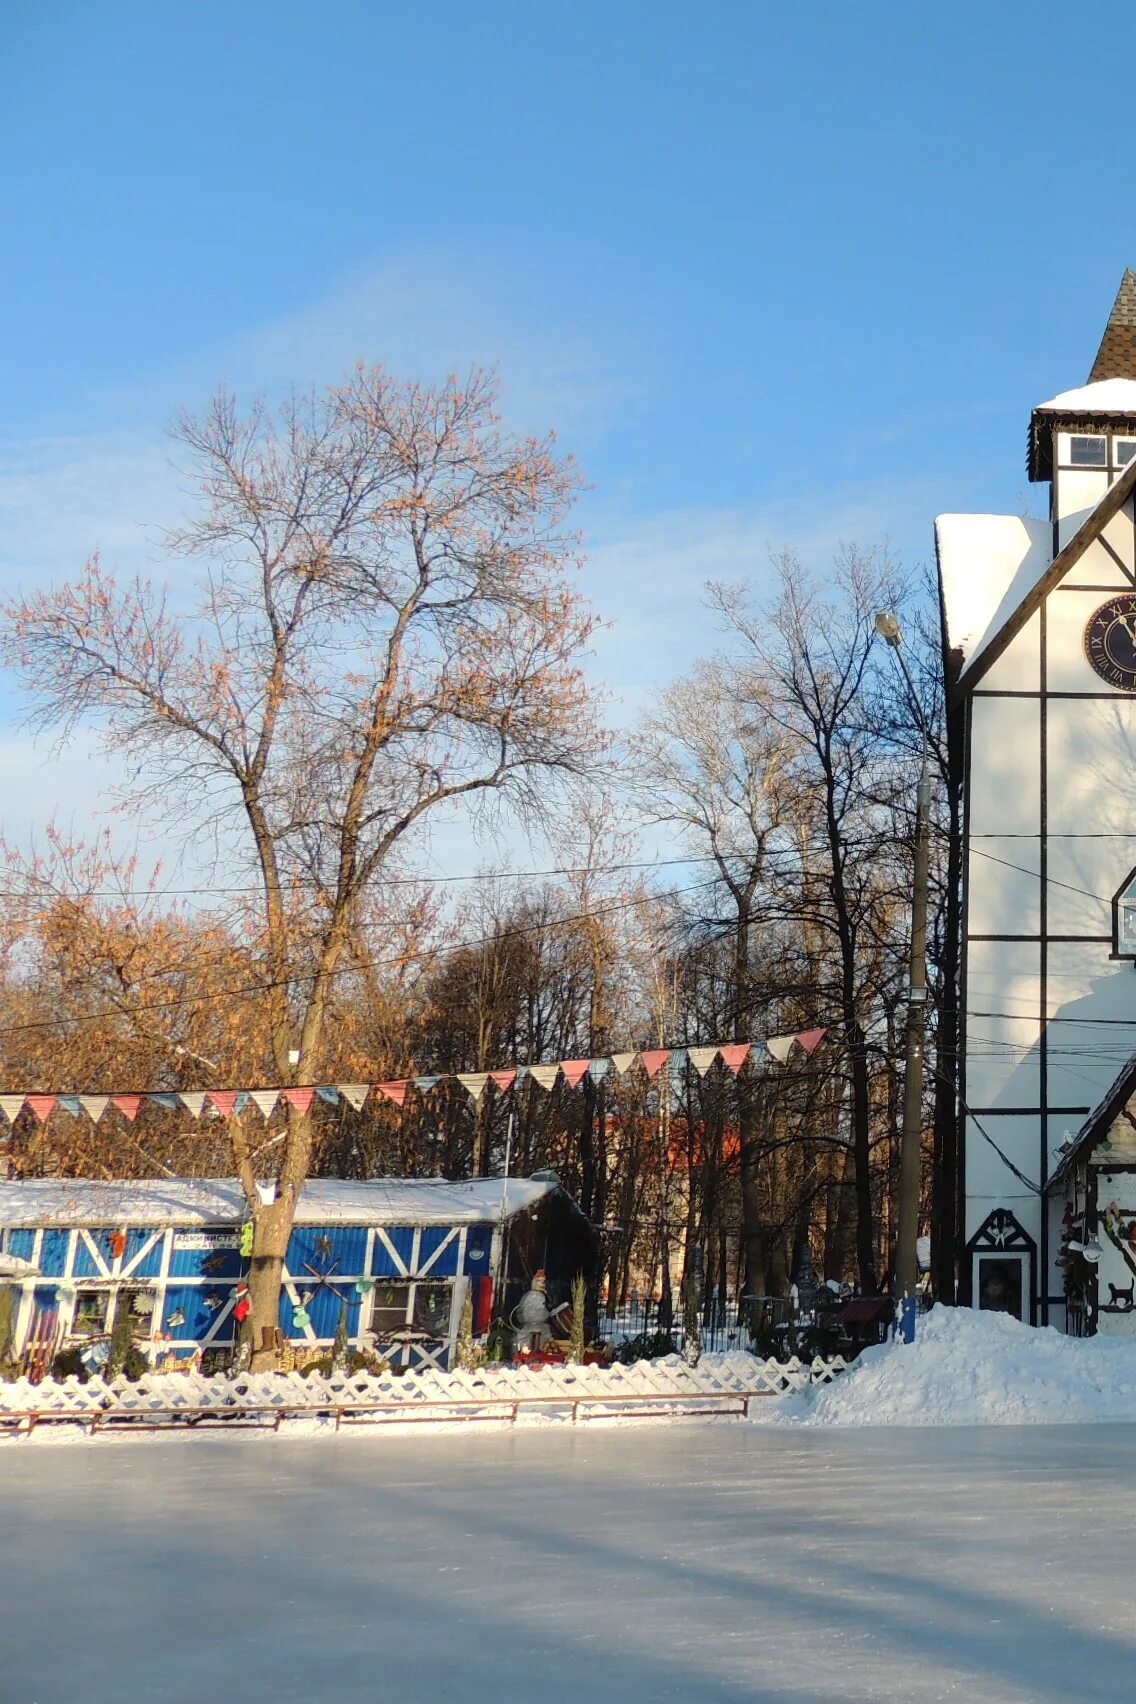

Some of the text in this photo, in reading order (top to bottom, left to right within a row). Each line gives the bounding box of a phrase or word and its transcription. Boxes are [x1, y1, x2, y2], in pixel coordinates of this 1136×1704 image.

[1109, 604, 1123, 616] XI
[1096, 618, 1108, 628] X
[1091, 636, 1103, 649] IX
[1095, 653, 1110, 672] VIII
[1110, 669, 1124, 683] VII
